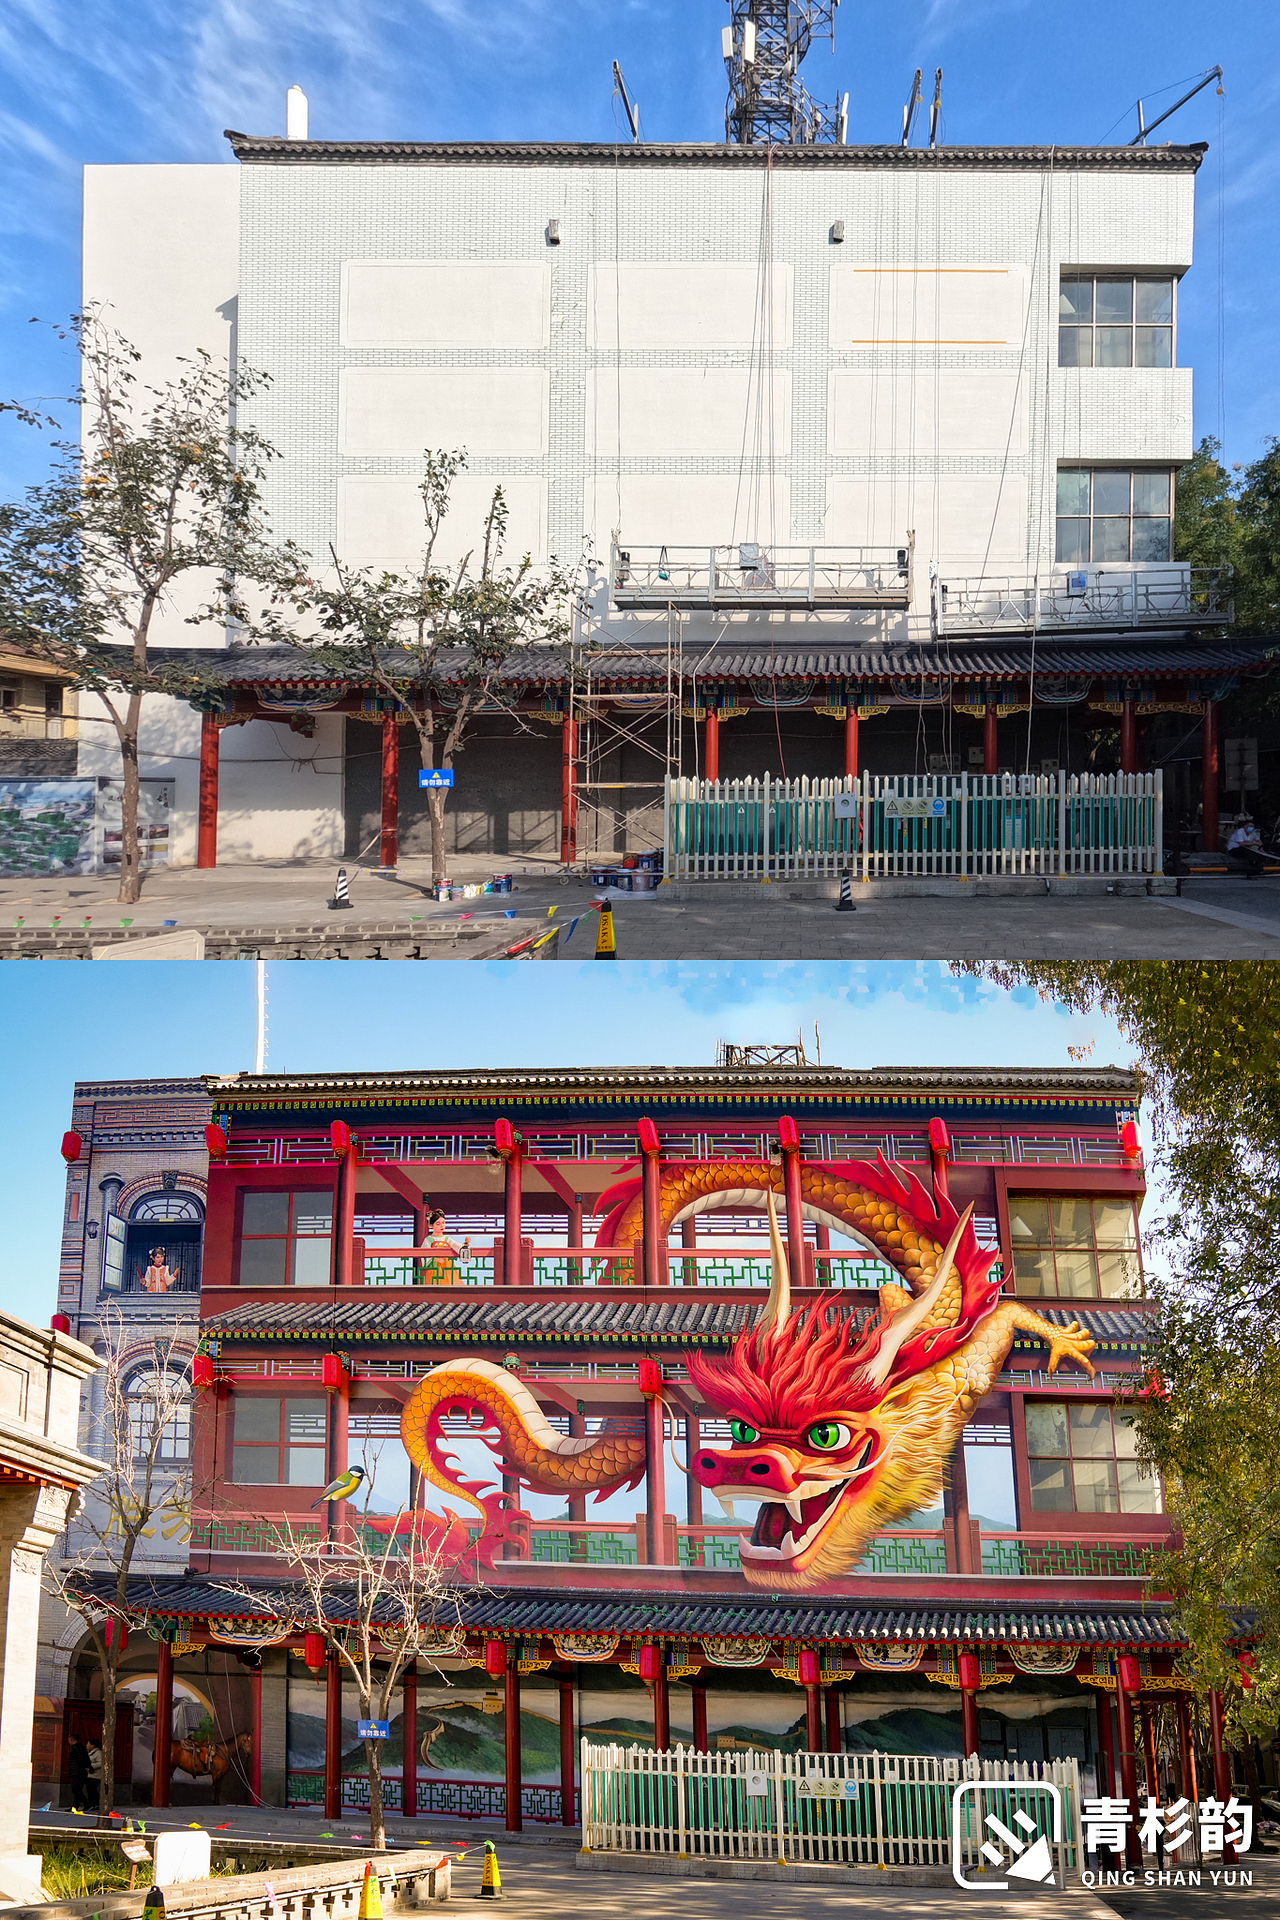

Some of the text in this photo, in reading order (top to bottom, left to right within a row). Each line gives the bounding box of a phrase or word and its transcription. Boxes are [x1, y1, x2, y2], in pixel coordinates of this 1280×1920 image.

[601, 914, 609, 944] OSAKA
[360, 1729, 387, 1737] 请勿靠近
